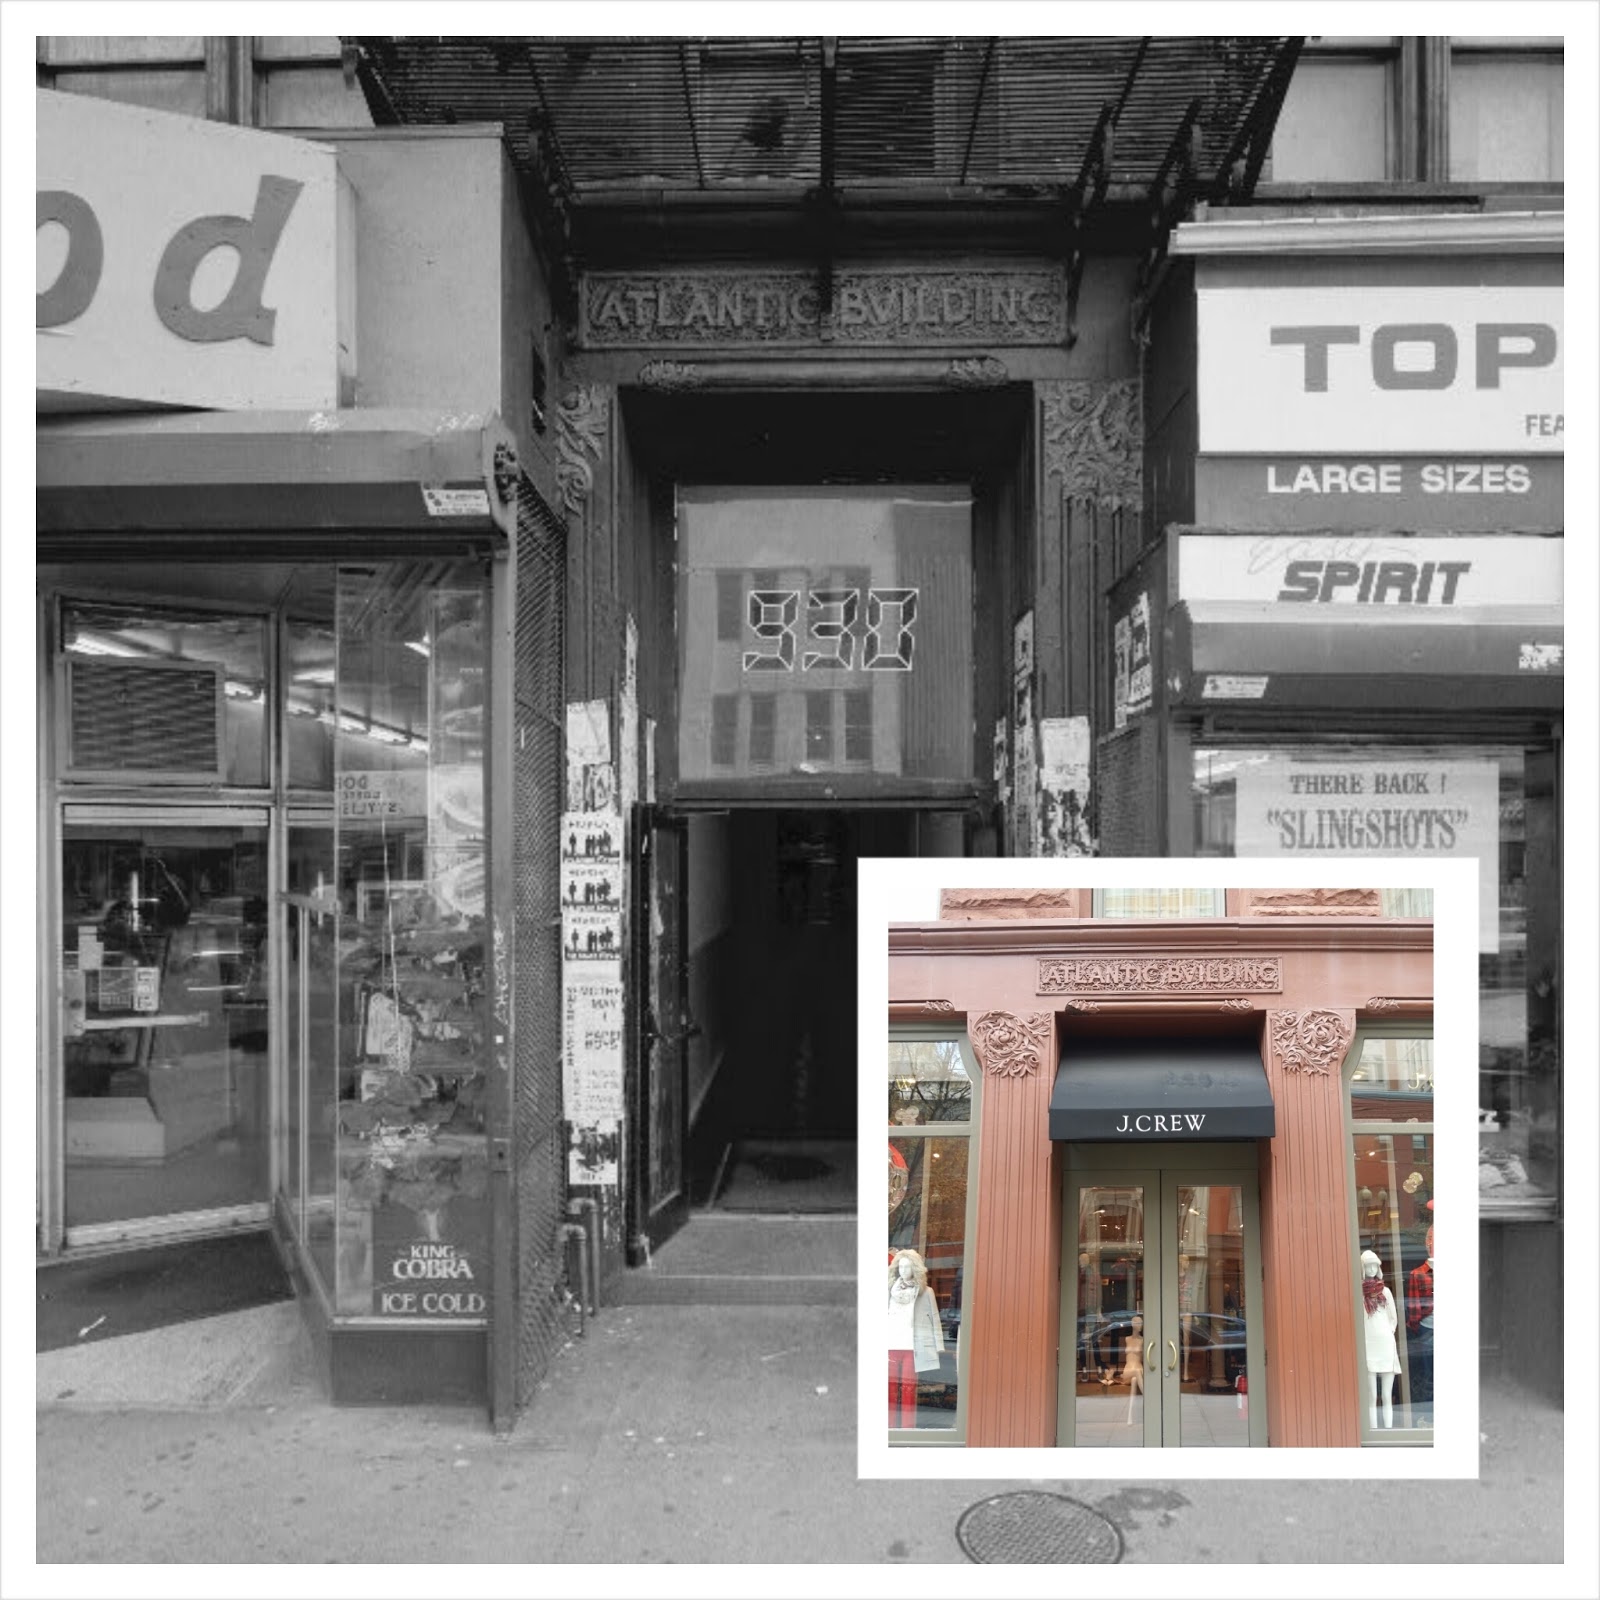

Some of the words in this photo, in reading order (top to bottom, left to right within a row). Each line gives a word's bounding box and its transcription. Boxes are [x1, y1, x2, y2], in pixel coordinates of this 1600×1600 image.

[599, 288, 821, 327] ATLANTIC
[1270, 323, 1557, 393] TOP
[1267, 465, 1402, 493] LARGE
[1420, 464, 1532, 493] SIZES
[1277, 560, 1471, 604] SPIRIT
[742, 588, 919, 672] 930
[1289, 774, 1363, 795] THERE
[1374, 772, 1430, 794] BACK
[1043, 963, 1158, 984] ATLANTIC
[1116, 1115, 1206, 1132] J.CREW
[411, 1245, 455, 1258] KING
[393, 1259, 474, 1279] COBRA
[382, 1293, 417, 1313] ICE
[422, 1293, 485, 1313] COLD
